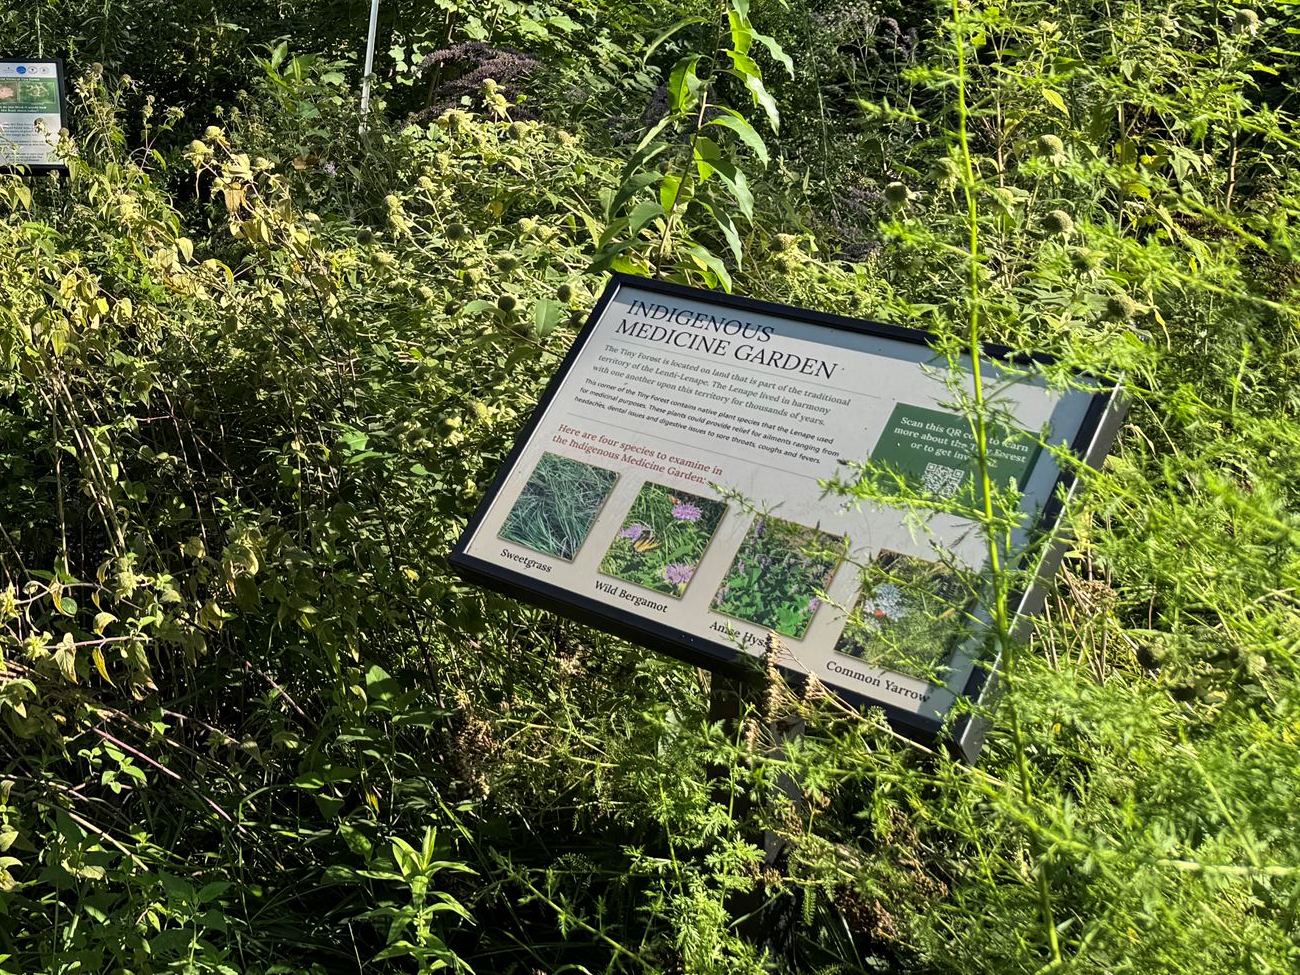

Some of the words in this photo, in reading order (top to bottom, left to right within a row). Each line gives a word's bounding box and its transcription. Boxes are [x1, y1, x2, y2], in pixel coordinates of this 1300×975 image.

[627, 300, 774, 343] INDIGENOUS
[615, 319, 730, 356] MEDICINE
[732, 344, 837, 379] GARDEN
[592, 365, 611, 373] with
[625, 374, 656, 384] another
[656, 381, 677, 389] upon
[677, 385, 694, 393] this
[694, 389, 730, 404] territory
[731, 397, 744, 405] for
[745, 401, 788, 416] thousands
[799, 415, 825, 425] years.
[598, 354, 631, 368] territory
[711, 381, 727, 390] The
[728, 385, 758, 398] Lenape
[758, 392, 780, 402] lived
[780, 397, 790, 405] in
[791, 400, 830, 417] harmony
[604, 344, 619, 352] The
[620, 348, 637, 358] Tiny
[637, 352, 662, 362] Forest
[670, 359, 700, 371] located
[712, 369, 731, 378] land
[731, 374, 748, 382] that
[757, 381, 777, 389] part
[788, 387, 802, 395] the
[803, 390, 852, 406] traditional
[589, 390, 619, 400] medicinal
[618, 398, 646, 408] purposes.
[648, 404, 666, 413] These
[666, 409, 687, 418] plants
[687, 415, 706, 423] could
[705, 420, 731, 429] provide
[732, 426, 751, 434] relief
[762, 433, 792, 445] ailments
[792, 442, 820, 454] ranging
[821, 447, 840, 457] from
[597, 382, 617, 390] corner
[637, 391, 650, 400] Tiny
[650, 394, 670, 403] Forest
[670, 400, 697, 410] contains
[697, 407, 718, 415] native
[717, 412, 737, 420] plant
[736, 417, 760, 426] species
[761, 422, 777, 430] that
[790, 429, 816, 441] Lenape
[607, 404, 628, 413] dental
[628, 409, 646, 418] issues
[659, 417, 687, 429] digestive
[688, 425, 707, 434] issues
[757, 444, 783, 454] coughs
[798, 453, 820, 464] fevers.
[894, 428, 919, 437] more
[920, 433, 948, 444] about
[900, 416, 924, 428] Scan
[925, 423, 944, 432] this
[944, 427, 963, 437] QR
[988, 437, 1000, 445] to
[552, 435, 568, 444] the
[569, 439, 620, 459] Indigenous
[620, 454, 665, 472] Medicine
[666, 467, 706, 484] Garden:
[558, 424, 581, 436] Here
[581, 432, 597, 440] are
[598, 435, 619, 446] four
[620, 443, 655, 456] species
[656, 452, 668, 460] to
[668, 456, 711, 472] examine
[711, 466, 723, 475] in
[923, 444, 934, 452] to
[500, 549, 552, 573] Sweetgrass
[593, 580, 618, 595] Wild
[618, 589, 669, 613] Bergamot
[709, 620, 741, 637] Anse
[825, 660, 881, 686] Common
[883, 679, 930, 703] Yarrow
